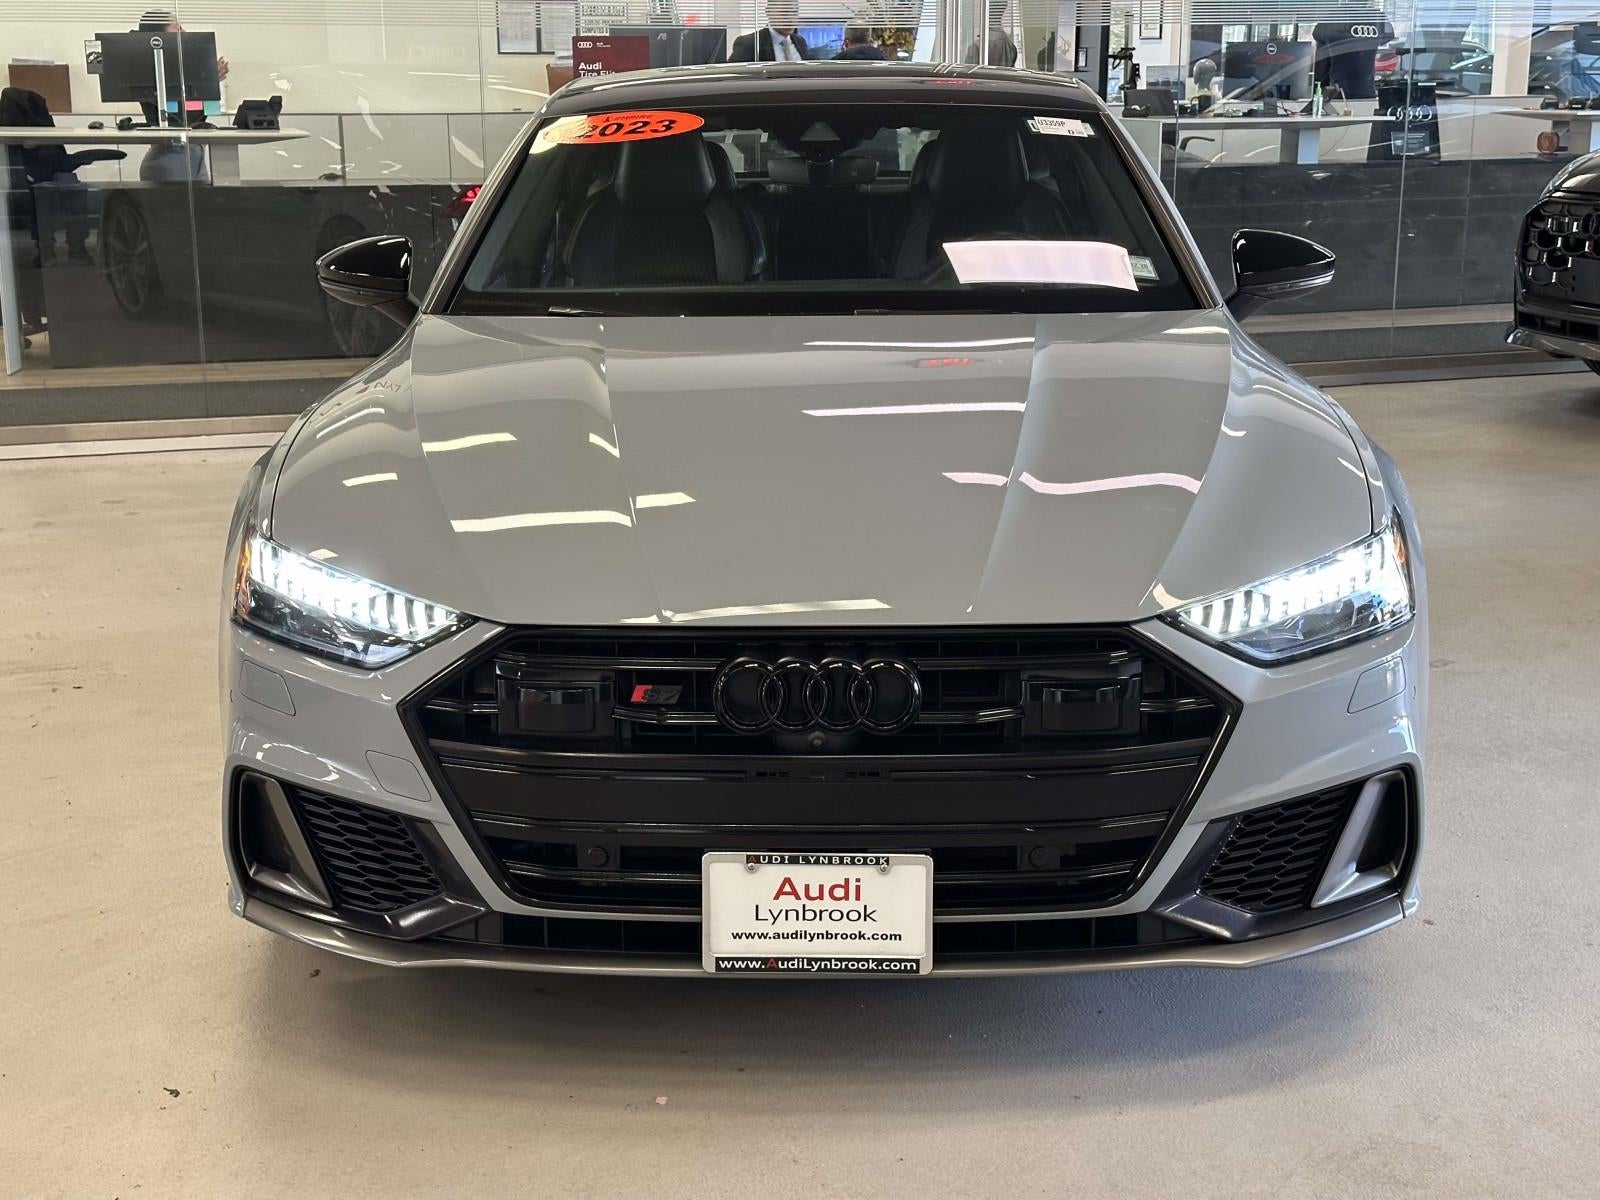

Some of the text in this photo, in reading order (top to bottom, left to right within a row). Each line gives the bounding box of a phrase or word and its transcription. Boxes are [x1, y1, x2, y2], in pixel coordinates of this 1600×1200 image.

[578, 62, 602, 70] Audi
[578, 70, 598, 79] Tire
[575, 119, 677, 138] 2023
[747, 855, 888, 865] AUDI LYNBROOK
[772, 876, 862, 902] Audi
[754, 903, 878, 925] Lynbrook
[731, 929, 902, 943] www.audilynbrook.com
[718, 957, 917, 972] www.AudiLynbrook.com
